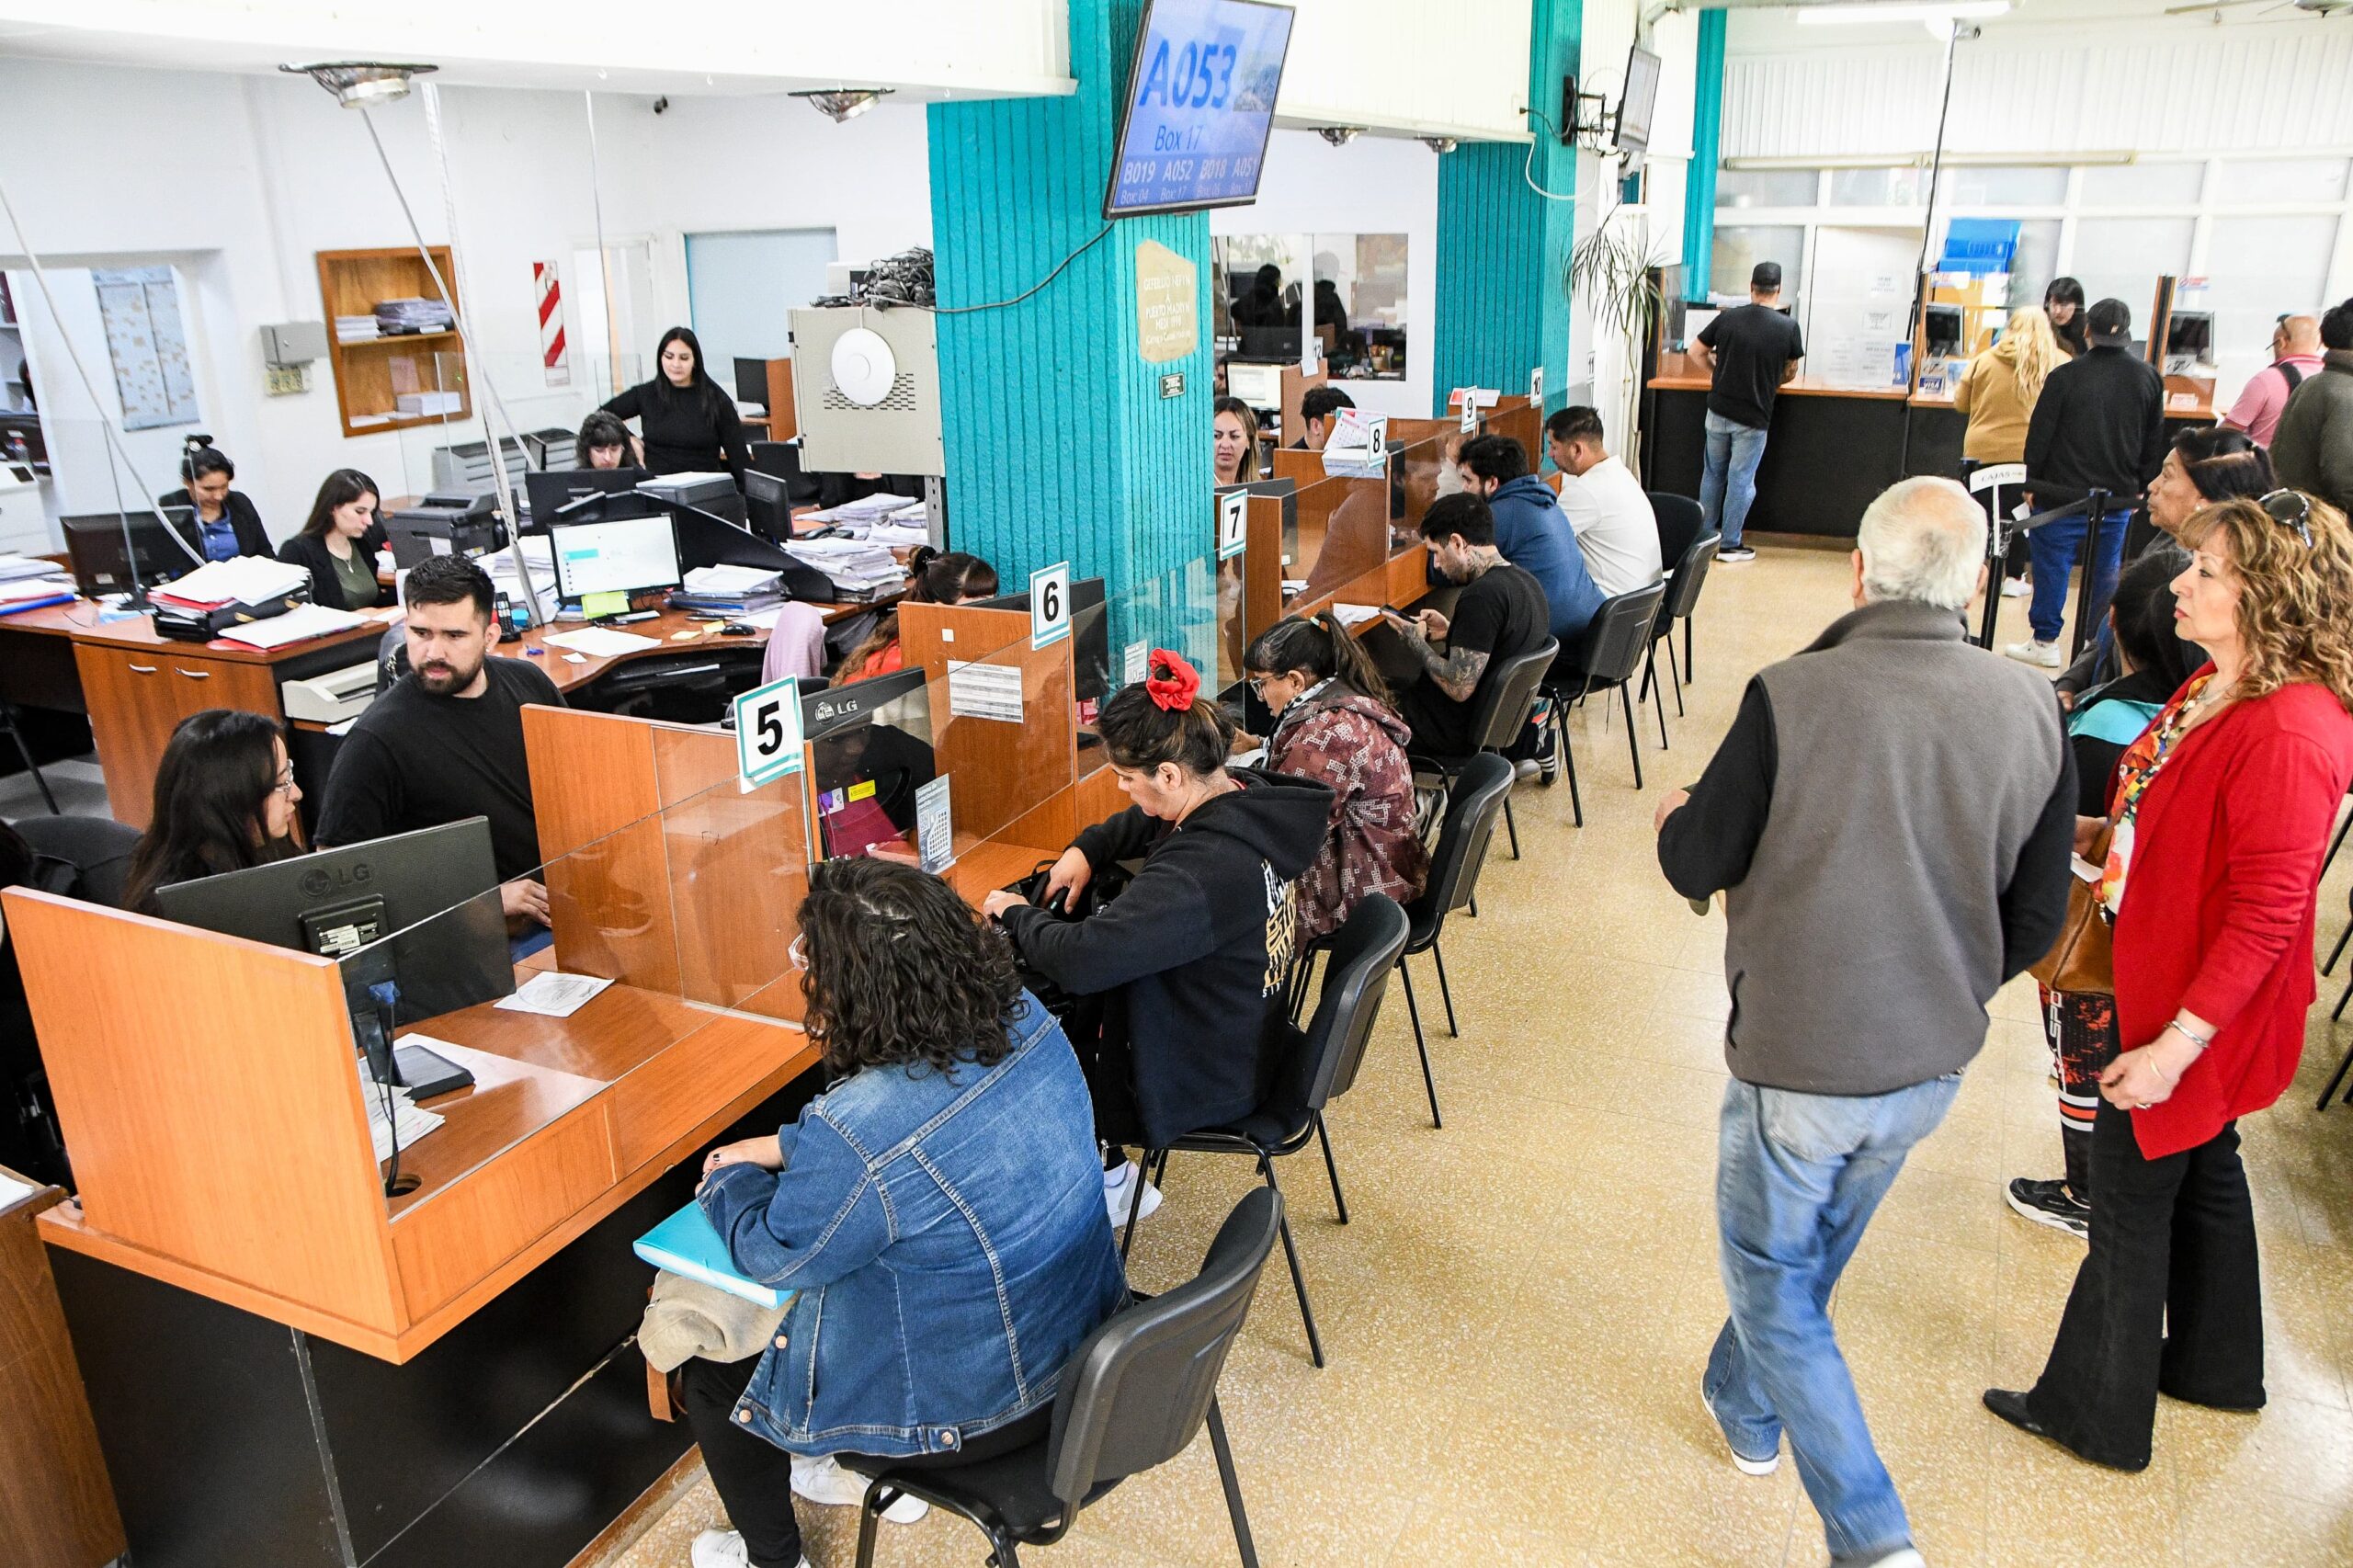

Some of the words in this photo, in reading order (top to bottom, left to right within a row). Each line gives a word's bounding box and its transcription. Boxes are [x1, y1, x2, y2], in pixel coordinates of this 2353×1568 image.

[1139, 40, 1237, 109] A053
[1154, 125, 1183, 152] Box
[1186, 124, 1204, 151] 17
[1123, 160, 1156, 185] B019
[1162, 159, 1194, 182] A052
[1199, 158, 1228, 179] B018
[1533, 376, 1541, 396] 10
[1467, 396, 1473, 419] 9
[1373, 428, 1381, 453] 8
[1981, 471, 2010, 483] CAJAS
[1230, 505, 1241, 539] 7
[1043, 581, 1059, 621] 6
[836, 699, 858, 715] LG
[757, 700, 783, 756] 5
[338, 863, 372, 888] LG
